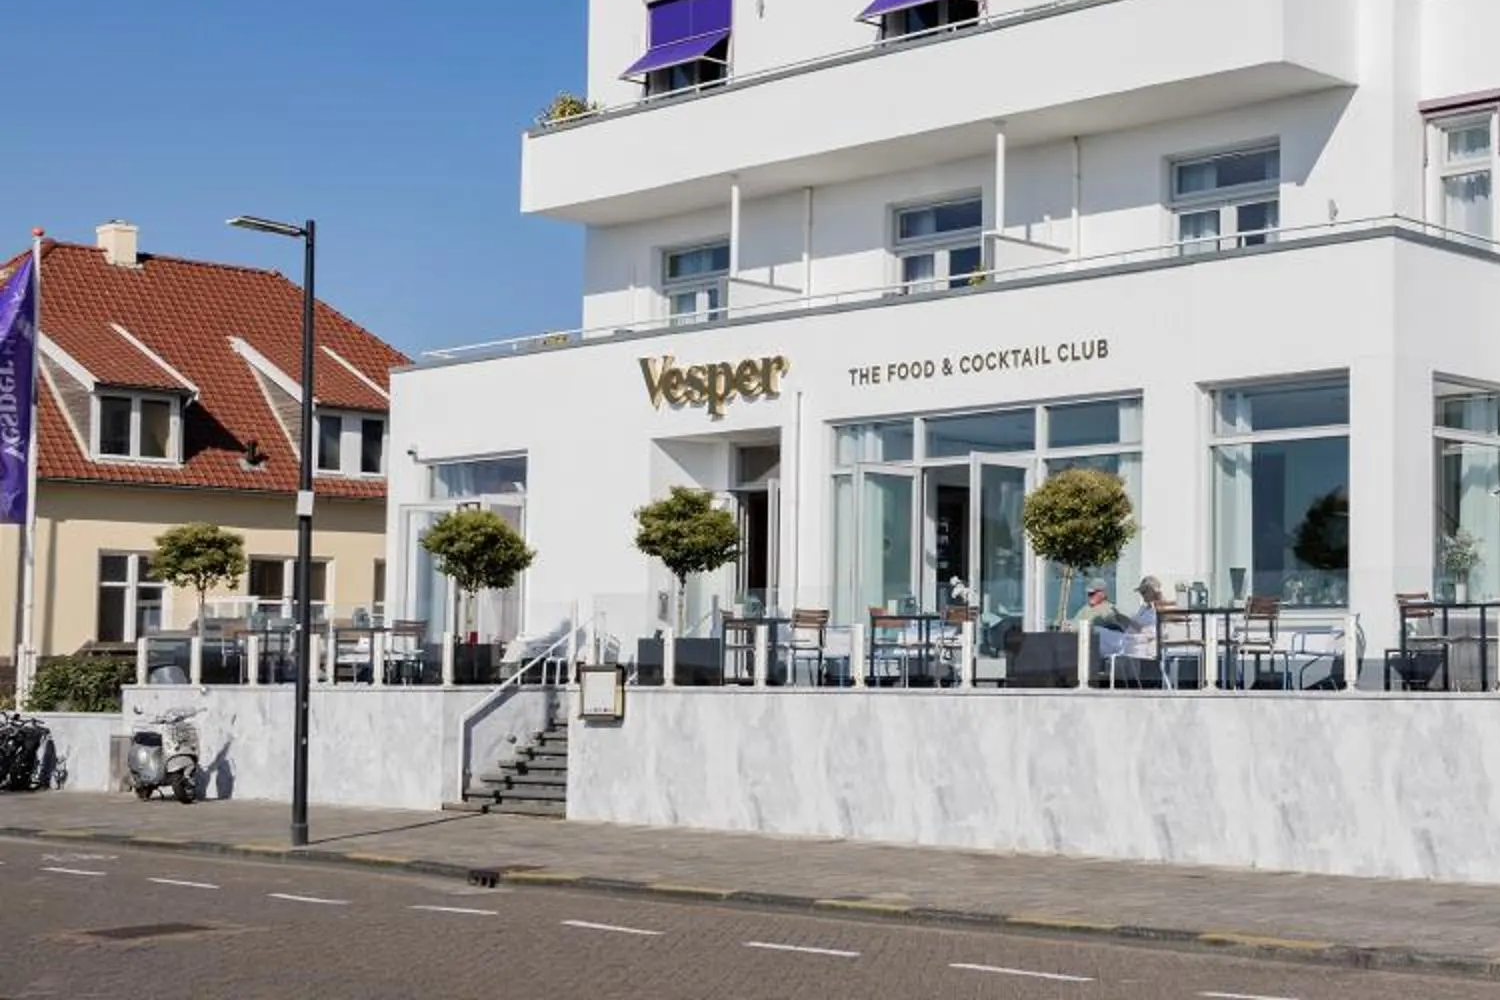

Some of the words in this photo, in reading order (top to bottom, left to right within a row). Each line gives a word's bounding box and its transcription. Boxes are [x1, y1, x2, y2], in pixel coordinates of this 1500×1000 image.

[639, 355, 790, 416] Vesper
[848, 366, 881, 386] THE
[887, 360, 935, 382] FOOD
[942, 358, 953, 376] &
[959, 347, 1051, 374] COCKTAIL
[1057, 339, 1109, 361] CLUB
